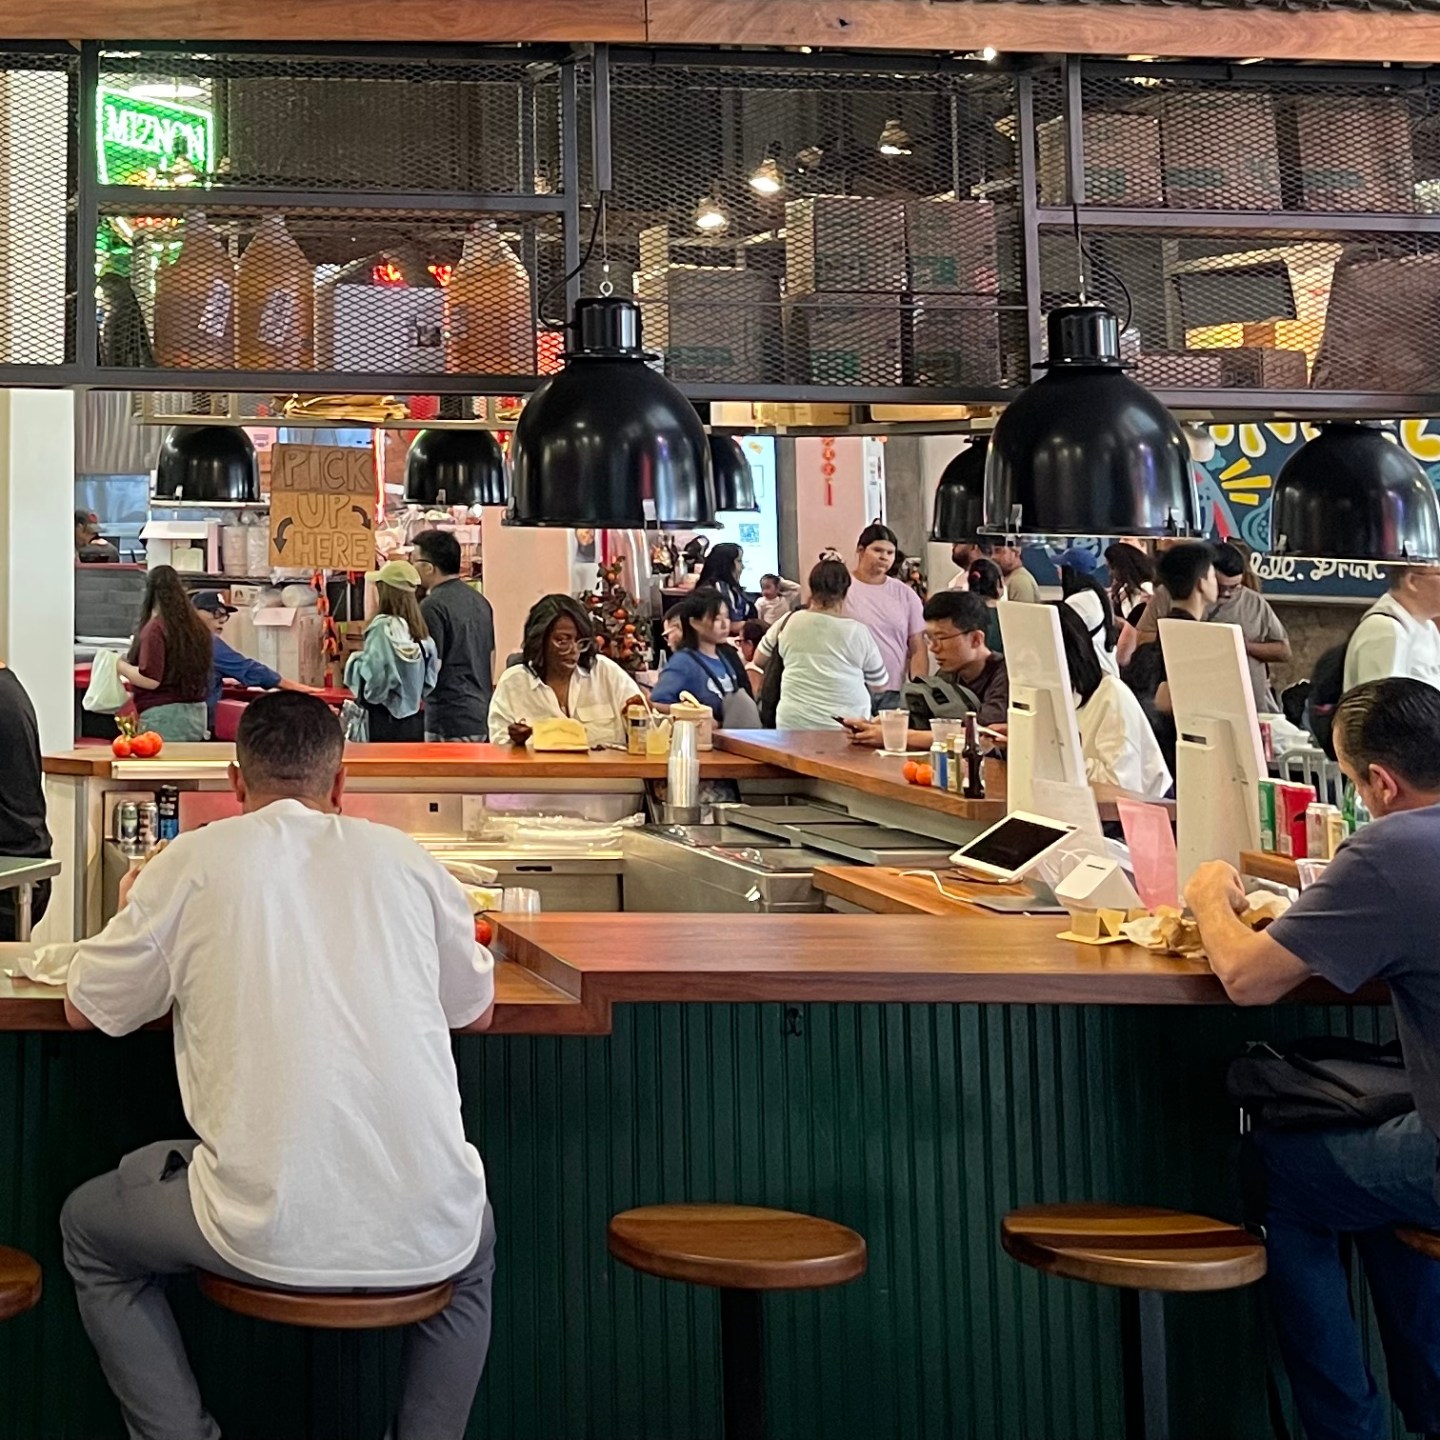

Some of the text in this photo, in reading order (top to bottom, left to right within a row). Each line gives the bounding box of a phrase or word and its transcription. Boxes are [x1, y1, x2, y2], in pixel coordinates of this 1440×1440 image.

[282, 449, 371, 491] PICK
[296, 492, 351, 529] UP
[292, 530, 370, 569] HERE
[1310, 557, 1386, 581] Drink
